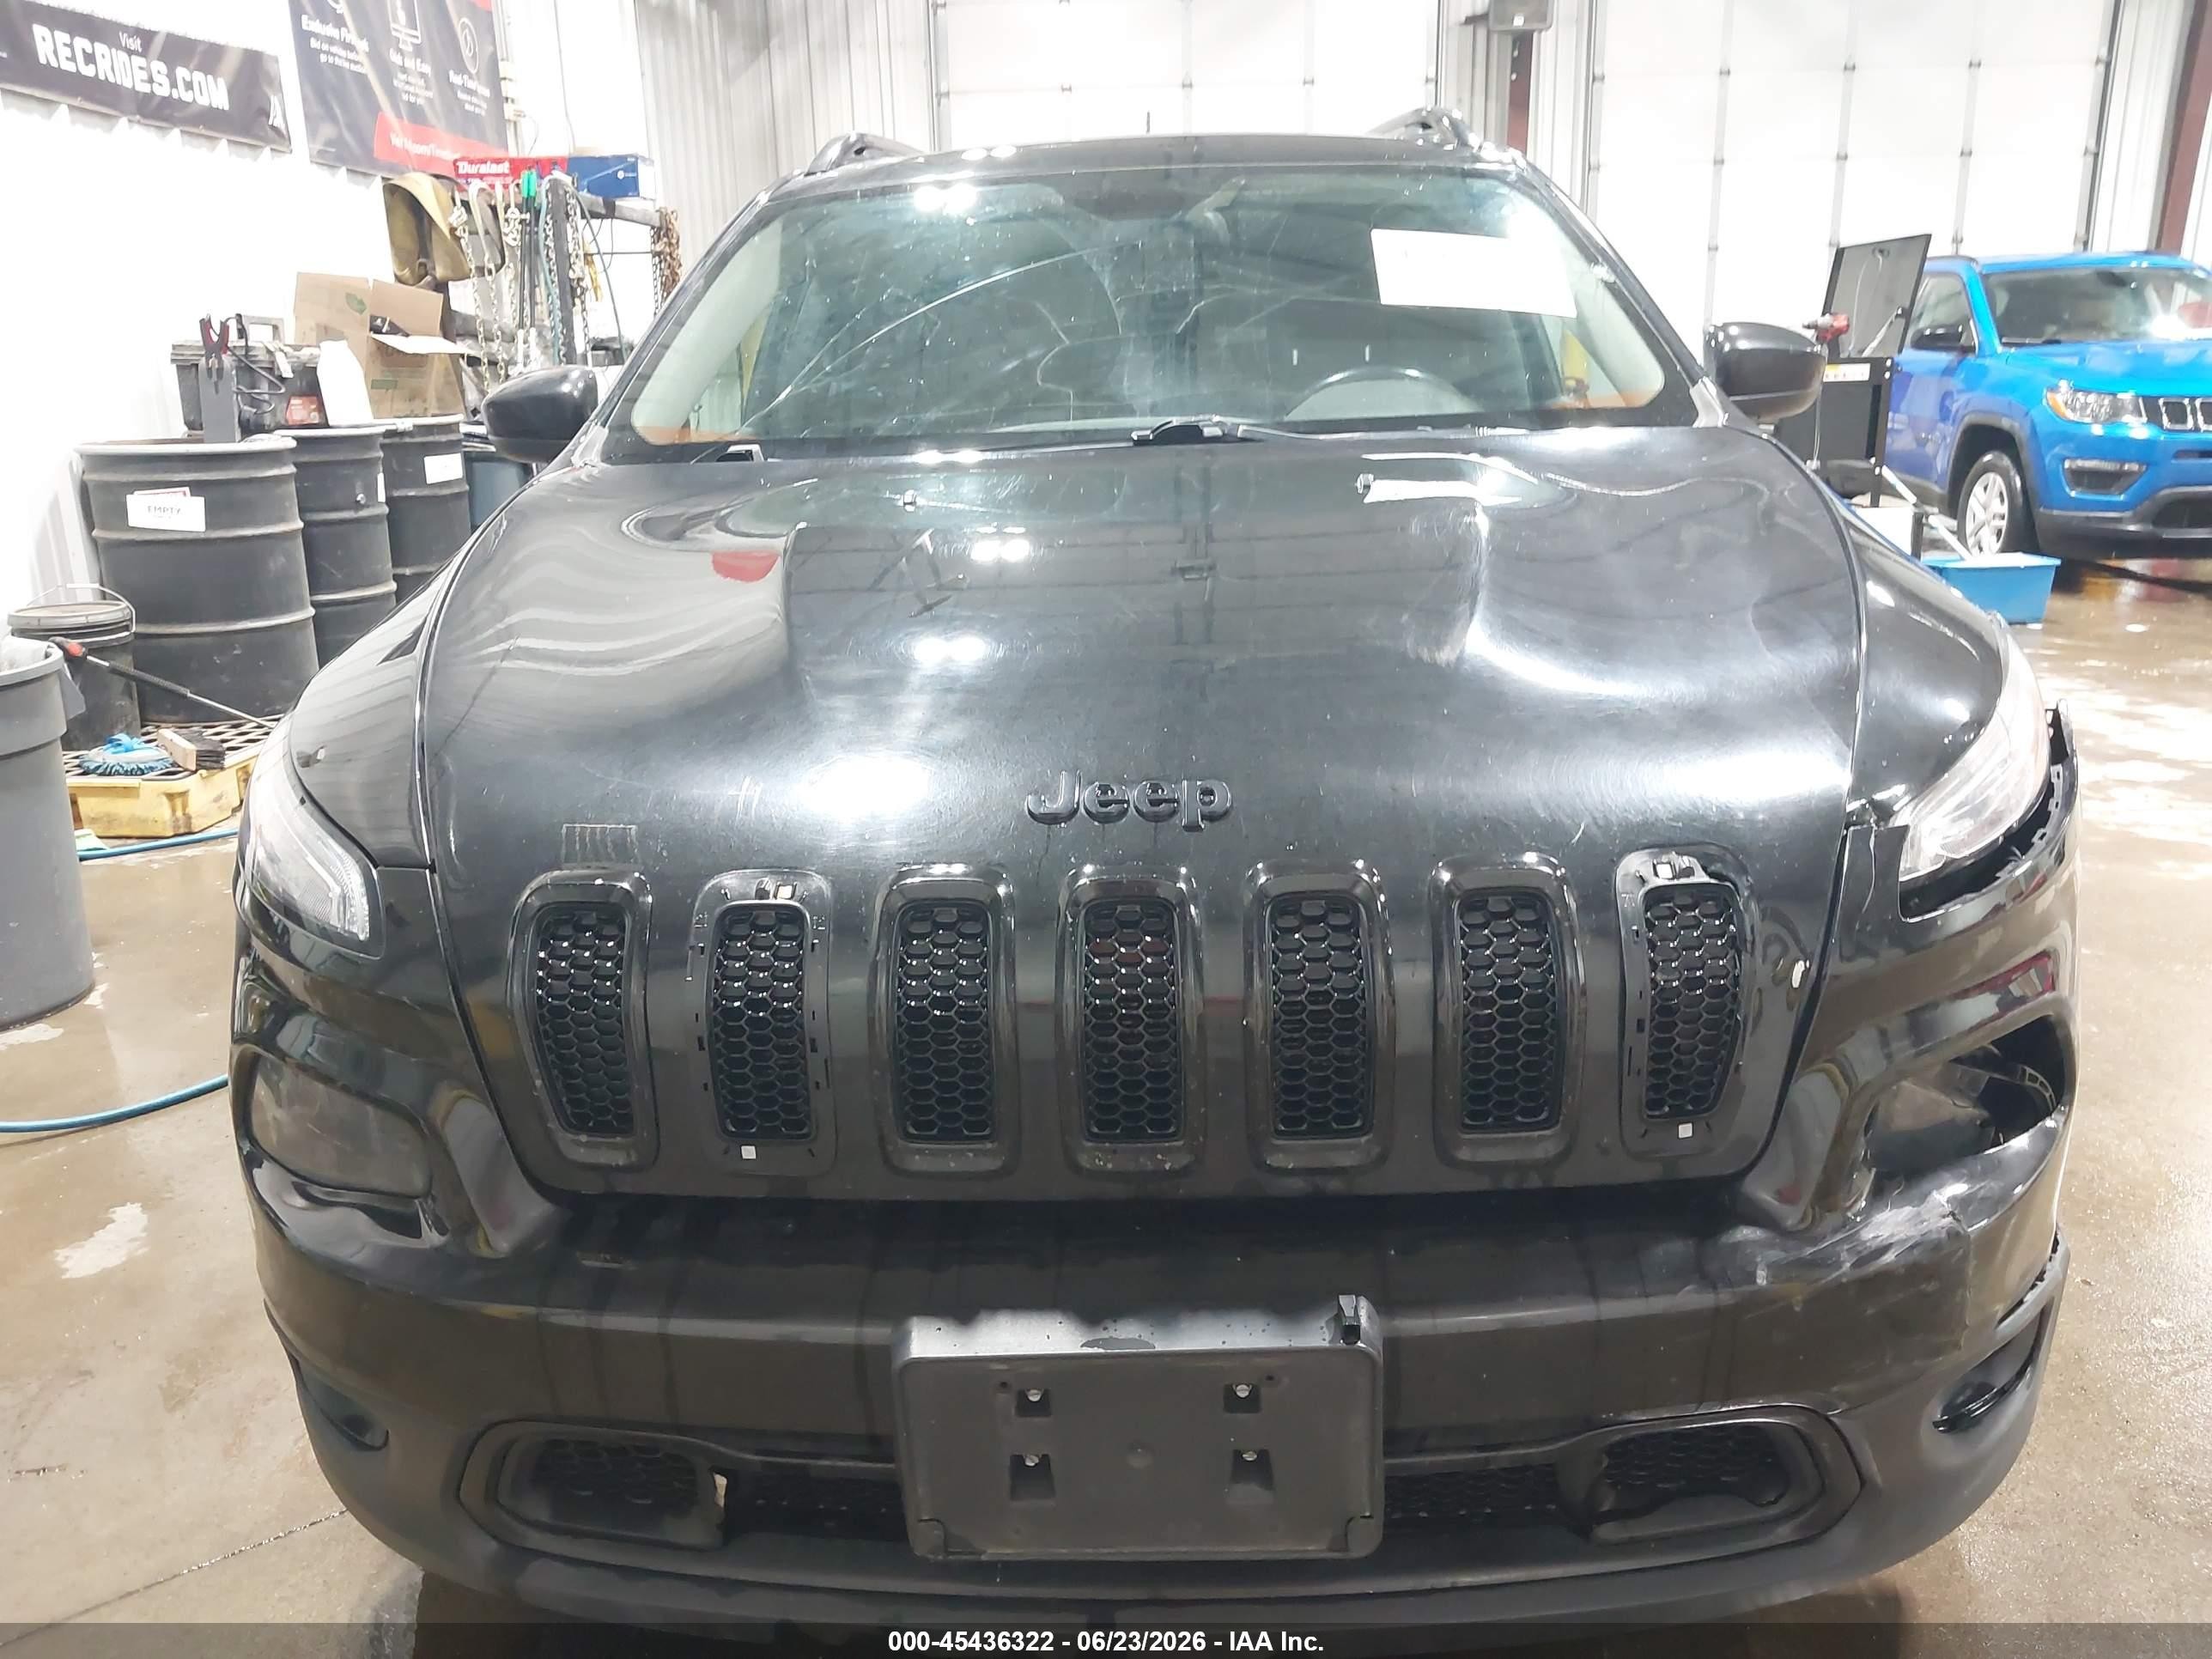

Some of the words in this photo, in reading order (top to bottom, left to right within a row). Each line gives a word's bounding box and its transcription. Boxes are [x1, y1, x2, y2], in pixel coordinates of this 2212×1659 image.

[118, 30, 143, 52] Visit
[32, 23, 229, 111] RECRIDES.COM
[456, 161, 510, 175] Duralast
[147, 505, 181, 515] EMPTY
[1025, 769, 1232, 832] Jeep
